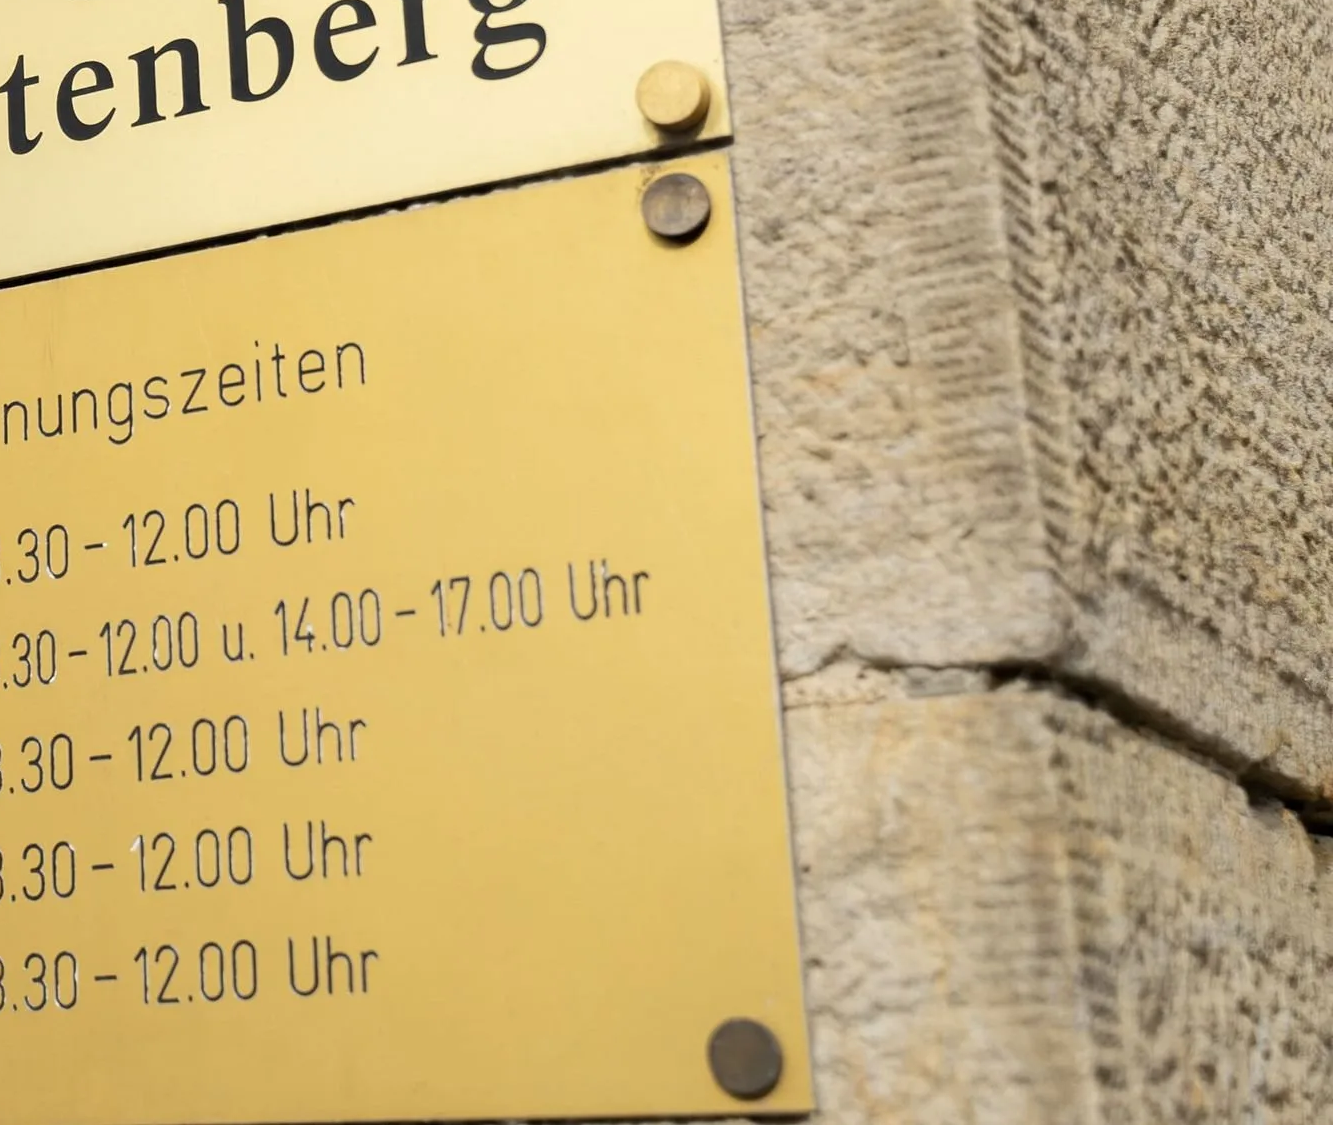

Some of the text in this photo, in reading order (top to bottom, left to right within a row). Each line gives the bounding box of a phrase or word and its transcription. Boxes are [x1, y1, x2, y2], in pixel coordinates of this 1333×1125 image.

[269, 487, 356, 548] Uhr
[220, 622, 256, 662] u.
[567, 558, 651, 622] Uhr
[277, 706, 368, 768] Uhr
[281, 818, 374, 882] Uhr
[286, 934, 380, 998] Uhr
